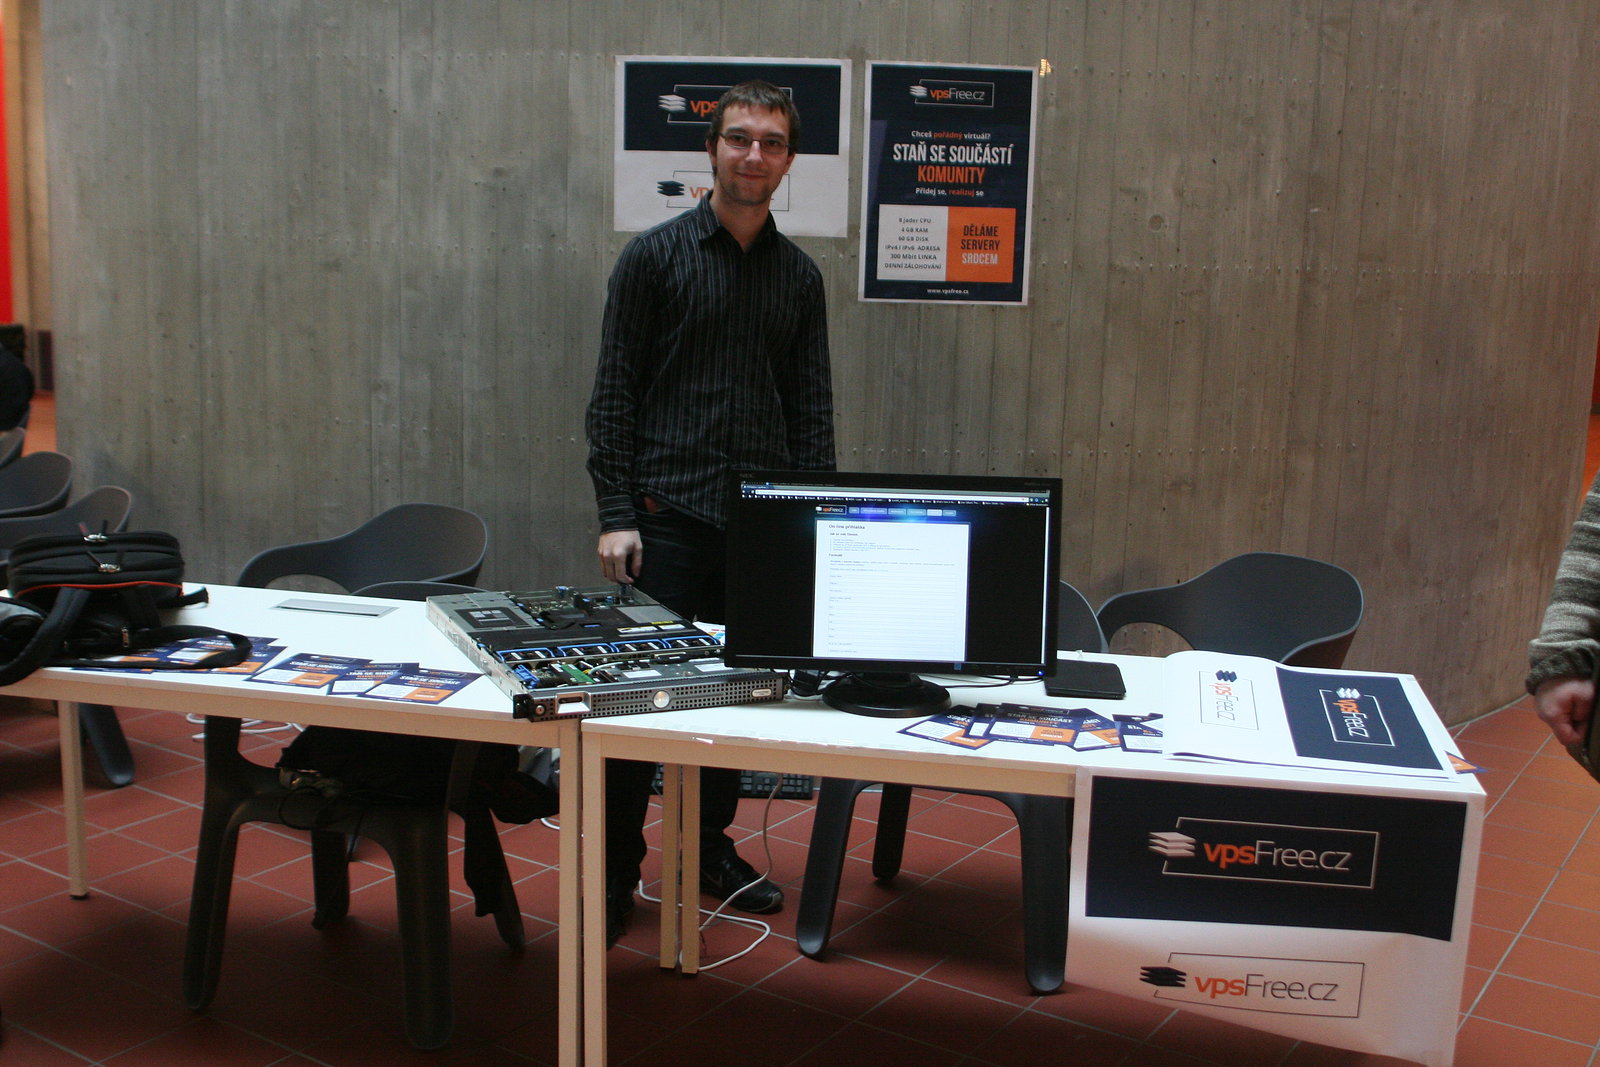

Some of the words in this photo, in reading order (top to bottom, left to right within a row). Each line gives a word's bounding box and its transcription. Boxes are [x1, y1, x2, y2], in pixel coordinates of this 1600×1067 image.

[911, 130, 932, 138] Chceš
[893, 141, 927, 161] STAŇ
[930, 145, 946, 162] SE
[949, 142, 1014, 165] SOUČÁSTÍ
[918, 165, 986, 184] KOMUNITY
[963, 224, 999, 237] DĚLÁME
[960, 239, 1000, 251] SERVERY
[961, 253, 998, 265] SRDCEM
[1203, 839, 1353, 871] vpsFree.cz
[1194, 973, 1338, 1002] vpsFree.cz
